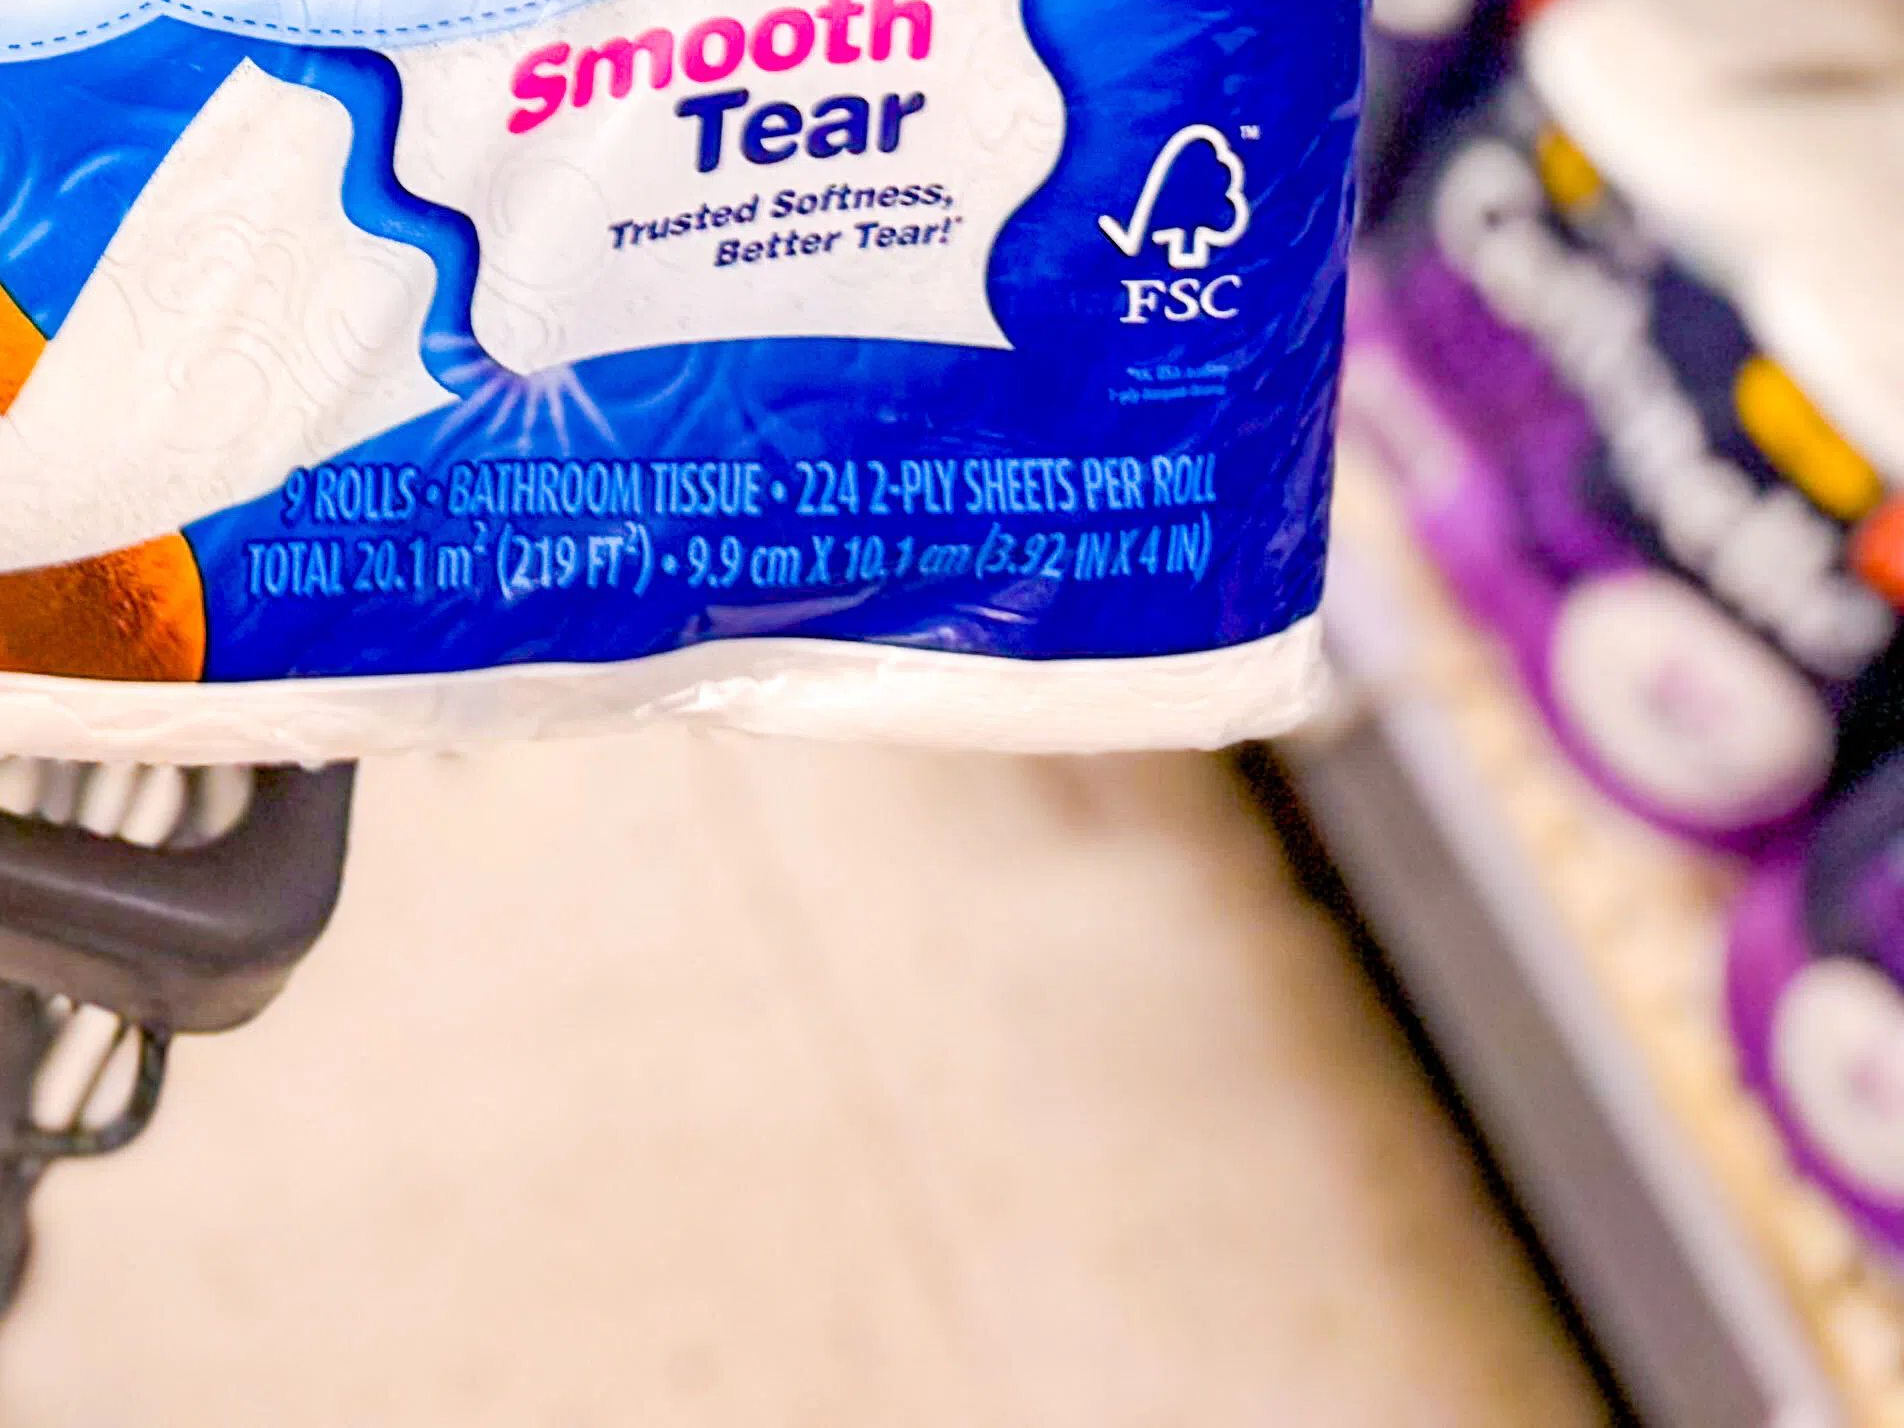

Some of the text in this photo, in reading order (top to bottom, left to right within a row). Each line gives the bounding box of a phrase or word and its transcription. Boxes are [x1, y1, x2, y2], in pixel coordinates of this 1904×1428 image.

[675, 86, 928, 174] Tear
[608, 181, 956, 251] Trusted Softness,
[713, 228, 844, 268] Better
[1119, 274, 1242, 325] FSC
[313, 462, 418, 522] ROLLS
[448, 460, 645, 517] BATHROOM
[650, 461, 763, 517] TISSUE
[795, 459, 860, 517] 224
[866, 458, 958, 516] 2-PLY
[963, 456, 1077, 515] SHEETS
[1081, 455, 1145, 512] PER
[1150, 452, 1218, 508] ROLL
[247, 541, 346, 598] TOTAL
[352, 536, 425, 592] 20.1
[496, 522, 578, 602] (219
[687, 534, 742, 588] 9.9
[749, 545, 803, 588] cm
[843, 534, 915, 584] 10.1
[918, 543, 974, 576] cm
[974, 521, 1067, 581] (3.92
[1073, 531, 1112, 581] IN
[1138, 524, 1162, 576] 4
